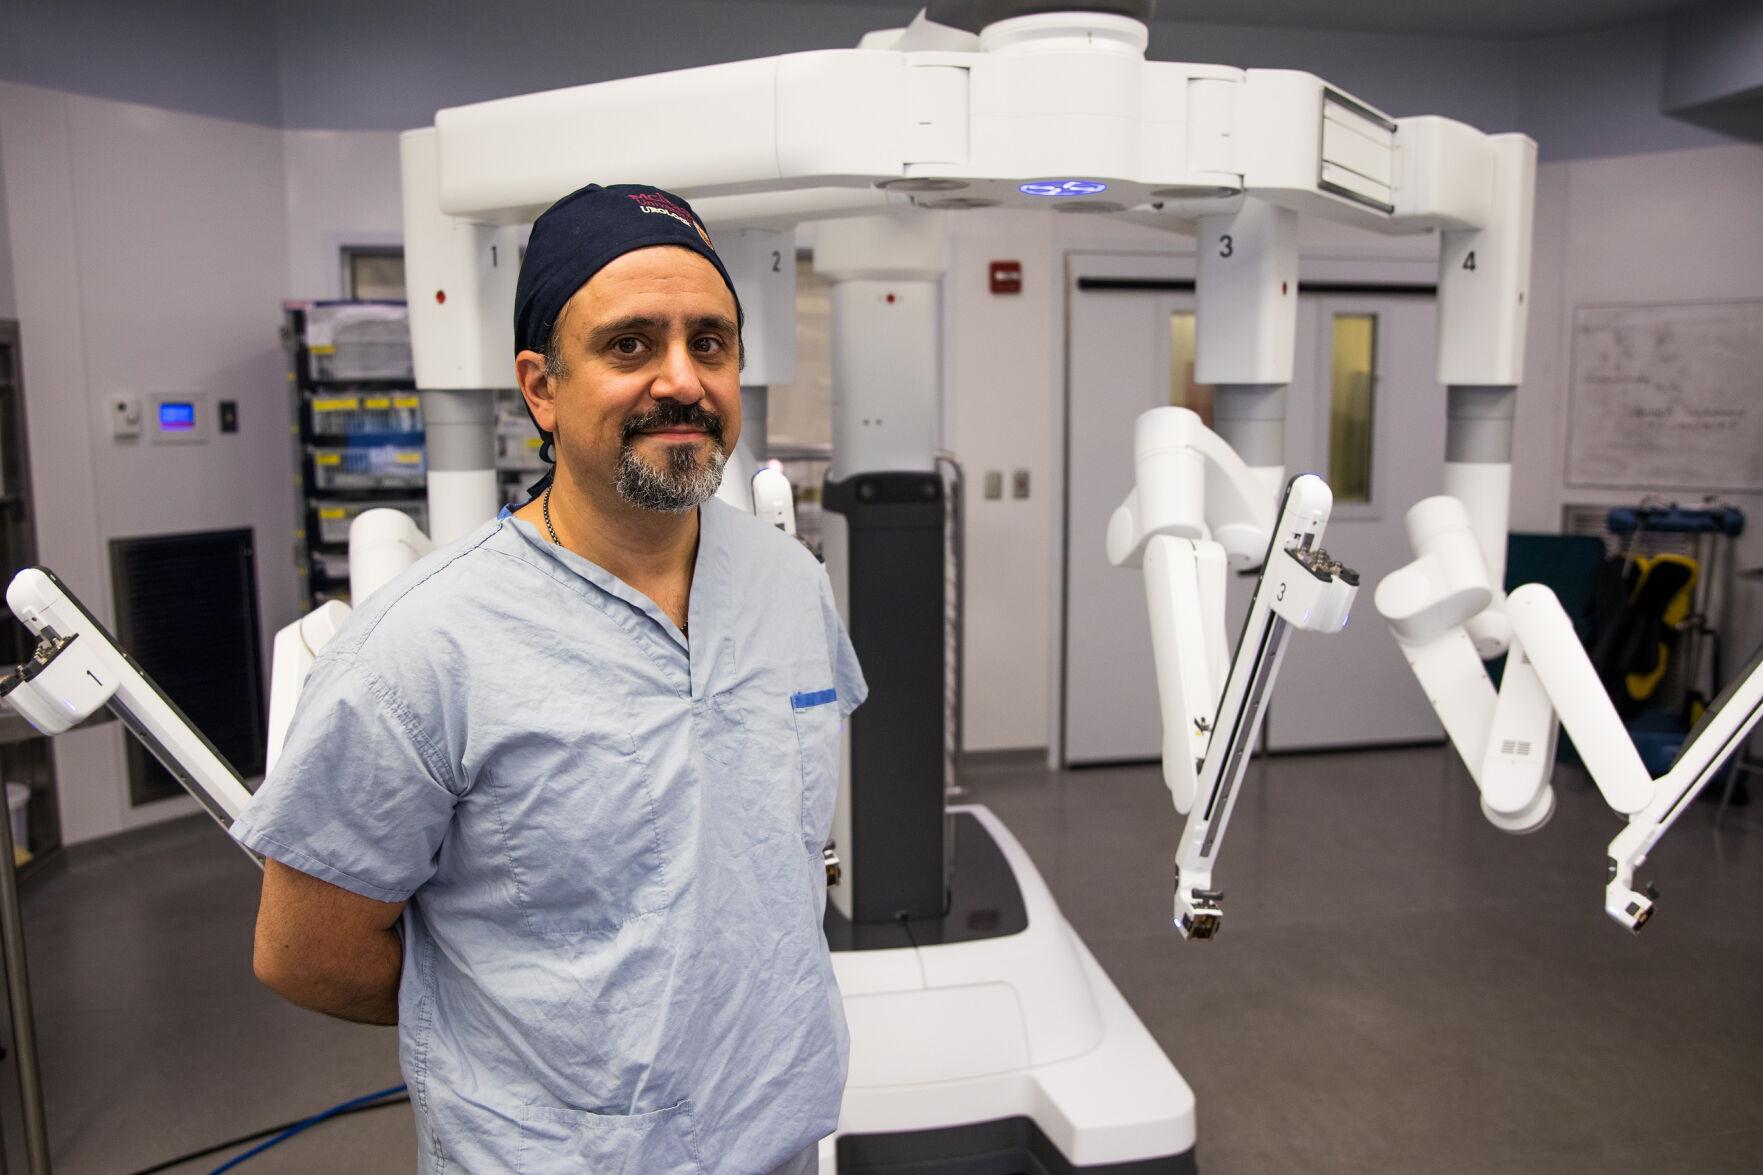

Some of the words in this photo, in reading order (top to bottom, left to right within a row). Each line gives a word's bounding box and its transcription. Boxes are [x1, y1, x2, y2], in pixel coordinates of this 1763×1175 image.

[491, 245, 498, 268] 1
[1219, 234, 1233, 258] 3
[771, 249, 782, 273] 2
[1462, 250, 1476, 271] 4
[1276, 582, 1287, 602] 3
[86, 669, 103, 687] 1
